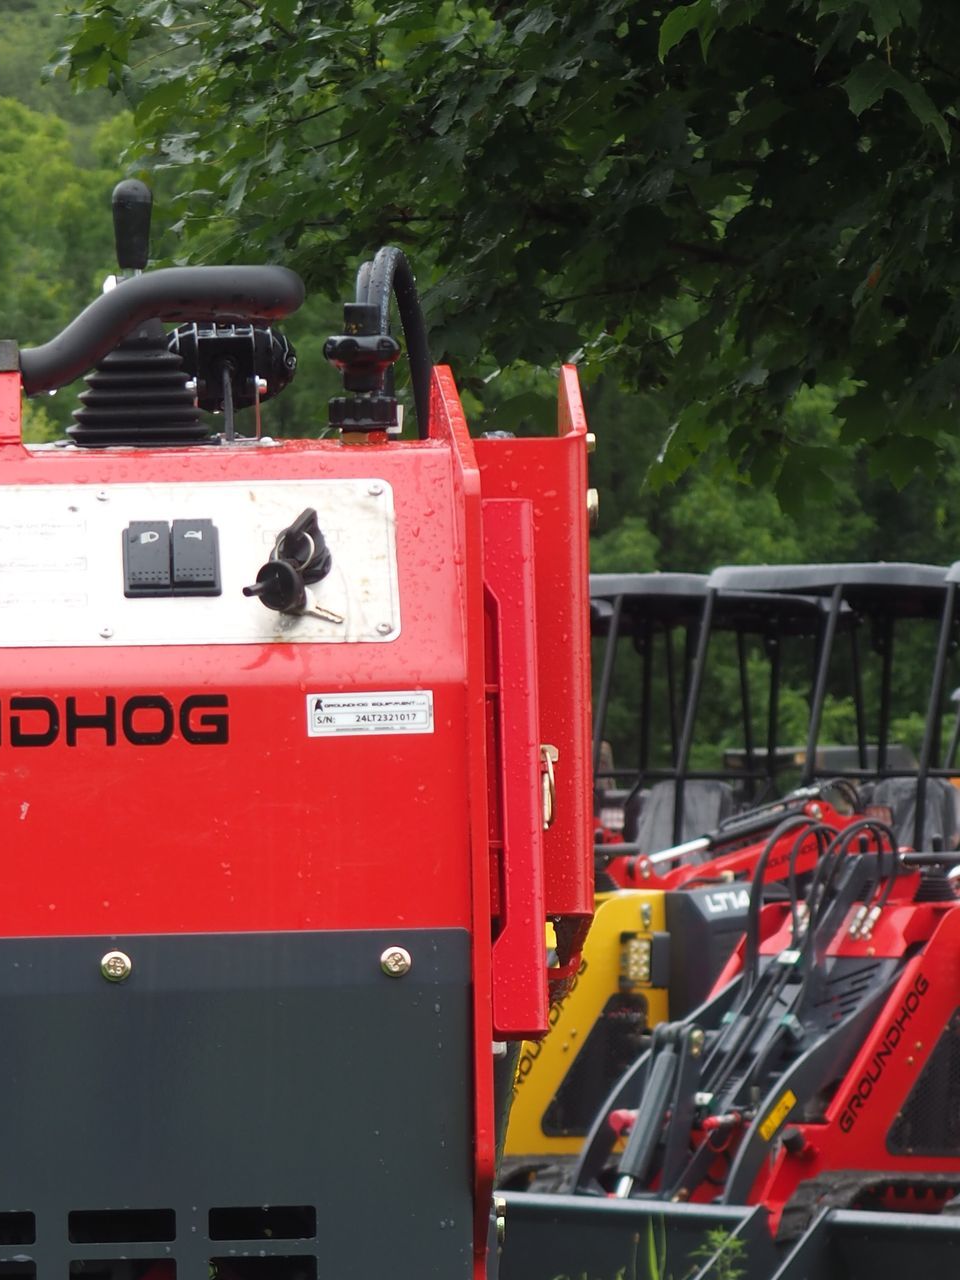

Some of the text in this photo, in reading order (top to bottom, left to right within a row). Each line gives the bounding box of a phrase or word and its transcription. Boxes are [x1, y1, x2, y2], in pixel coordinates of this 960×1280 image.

[324, 701, 368, 709] GROUNDHOG
[316, 713, 417, 725] S/N: 24LT2321017
[838, 973, 929, 1134] GROUNDHOG
